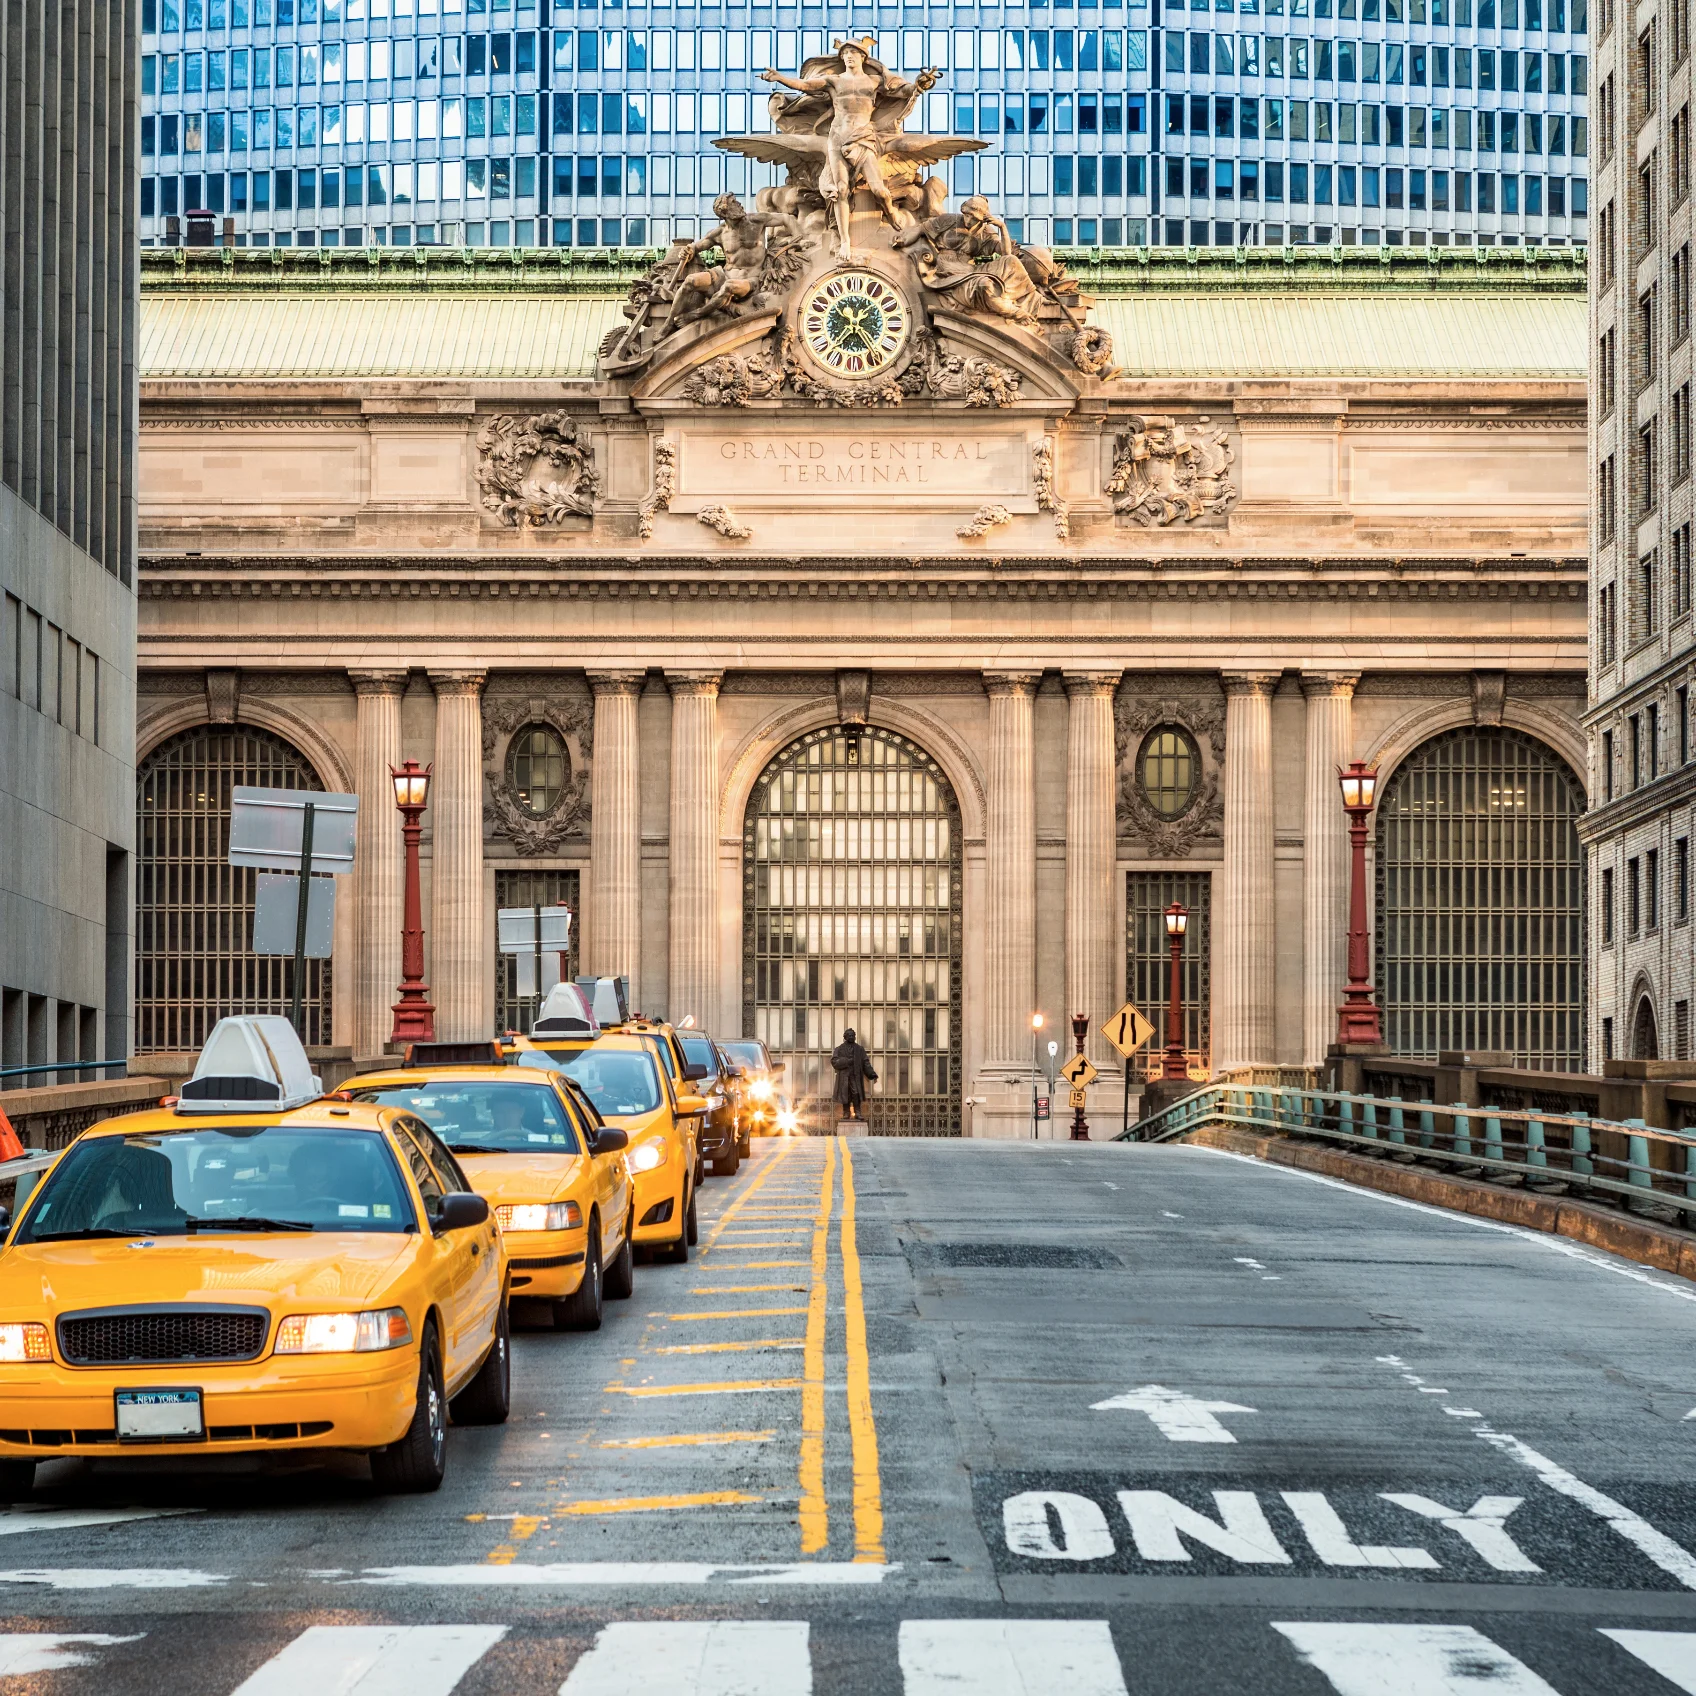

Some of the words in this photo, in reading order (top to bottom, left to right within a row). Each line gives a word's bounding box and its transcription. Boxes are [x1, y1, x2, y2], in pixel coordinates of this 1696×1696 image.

[828, 281, 841, 297] XI
[850, 276, 861, 293] XII
[812, 298, 828, 311] X
[720, 441, 825, 459] GRAND
[848, 441, 988, 460] CENTRAL
[778, 464, 929, 483] TERMINAL
[1073, 1092, 1083, 1101] 15
[137, 1395, 156, 1404] NEW
[157, 1394, 179, 1403] YORK
[1002, 1490, 1546, 1573] ONLY
